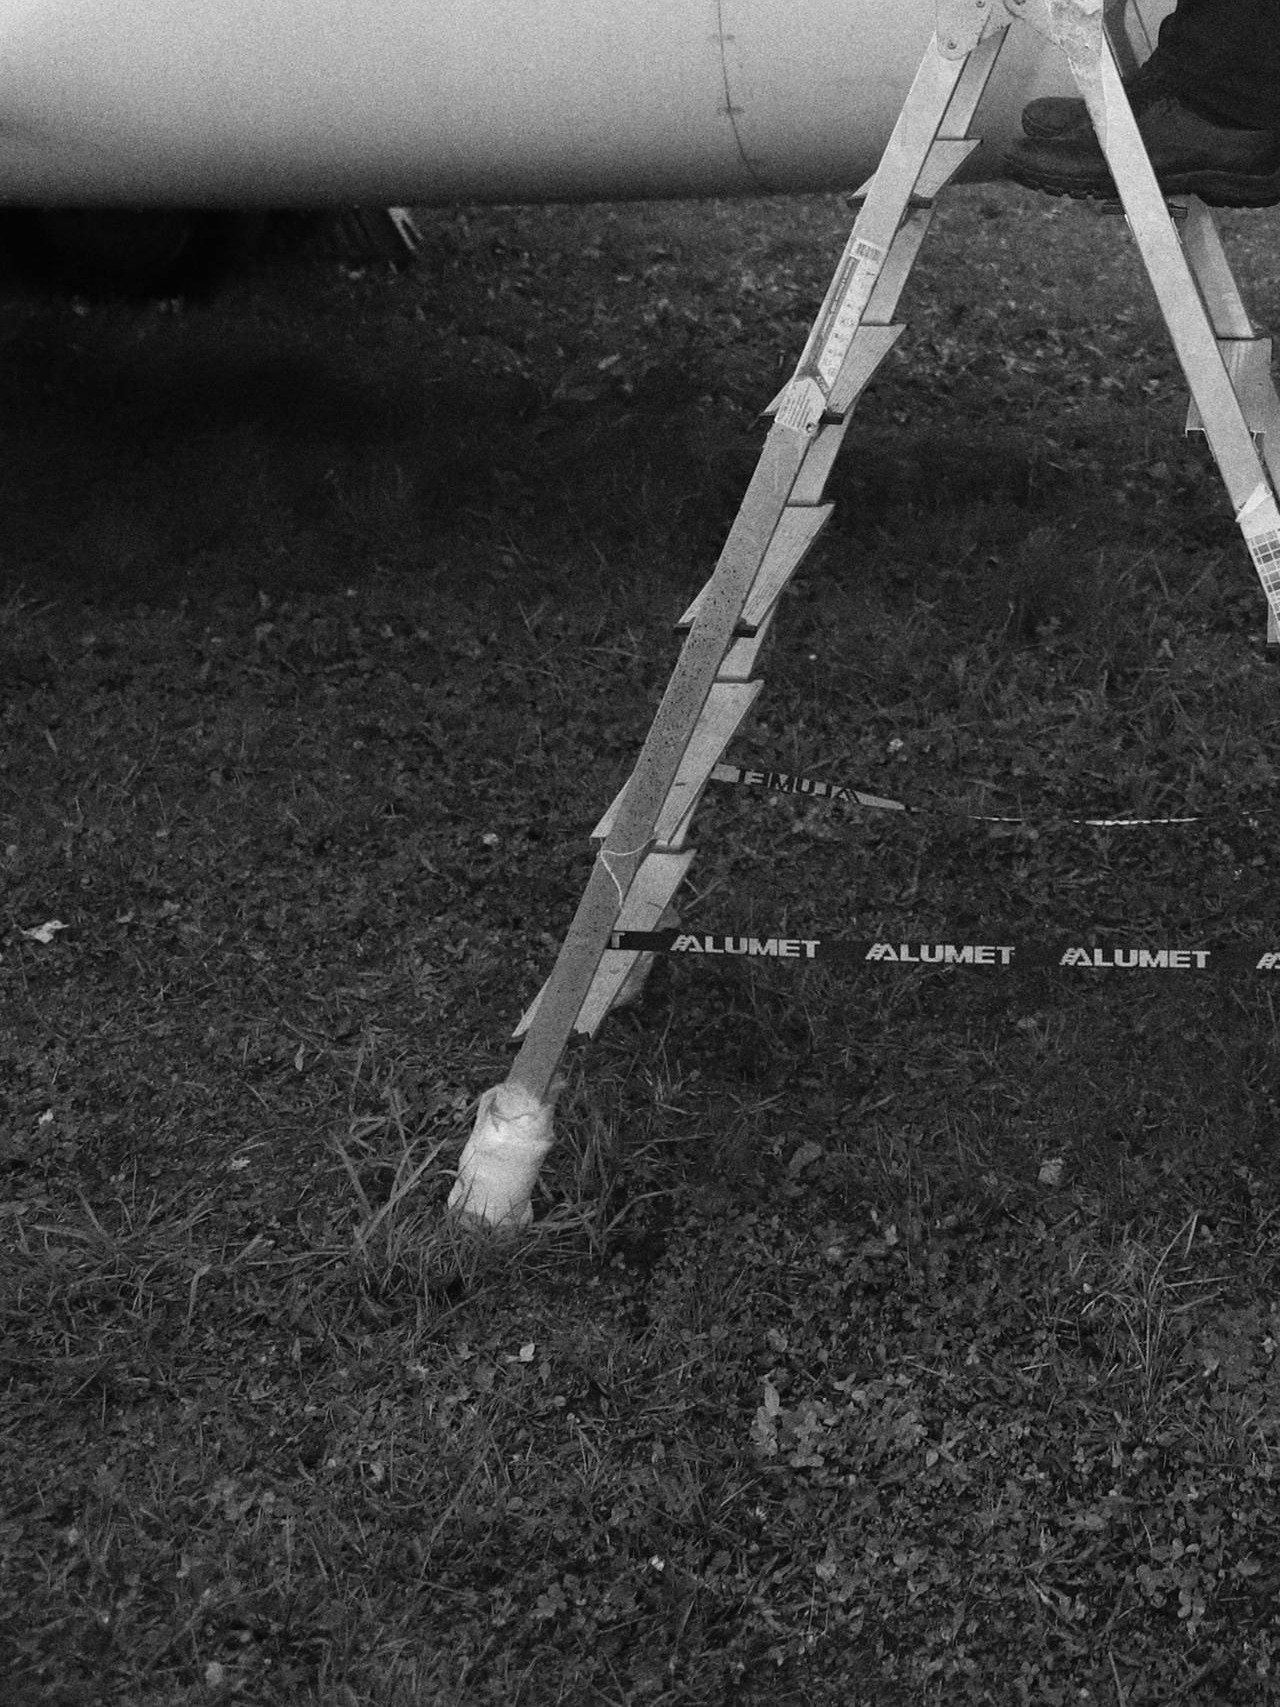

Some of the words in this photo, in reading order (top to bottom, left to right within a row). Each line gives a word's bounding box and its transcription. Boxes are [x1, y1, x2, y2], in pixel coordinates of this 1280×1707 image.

[670, 935, 821, 958] ALUMET
[865, 943, 1015, 964] ALUMET
[1059, 948, 1211, 968] ALUMET
